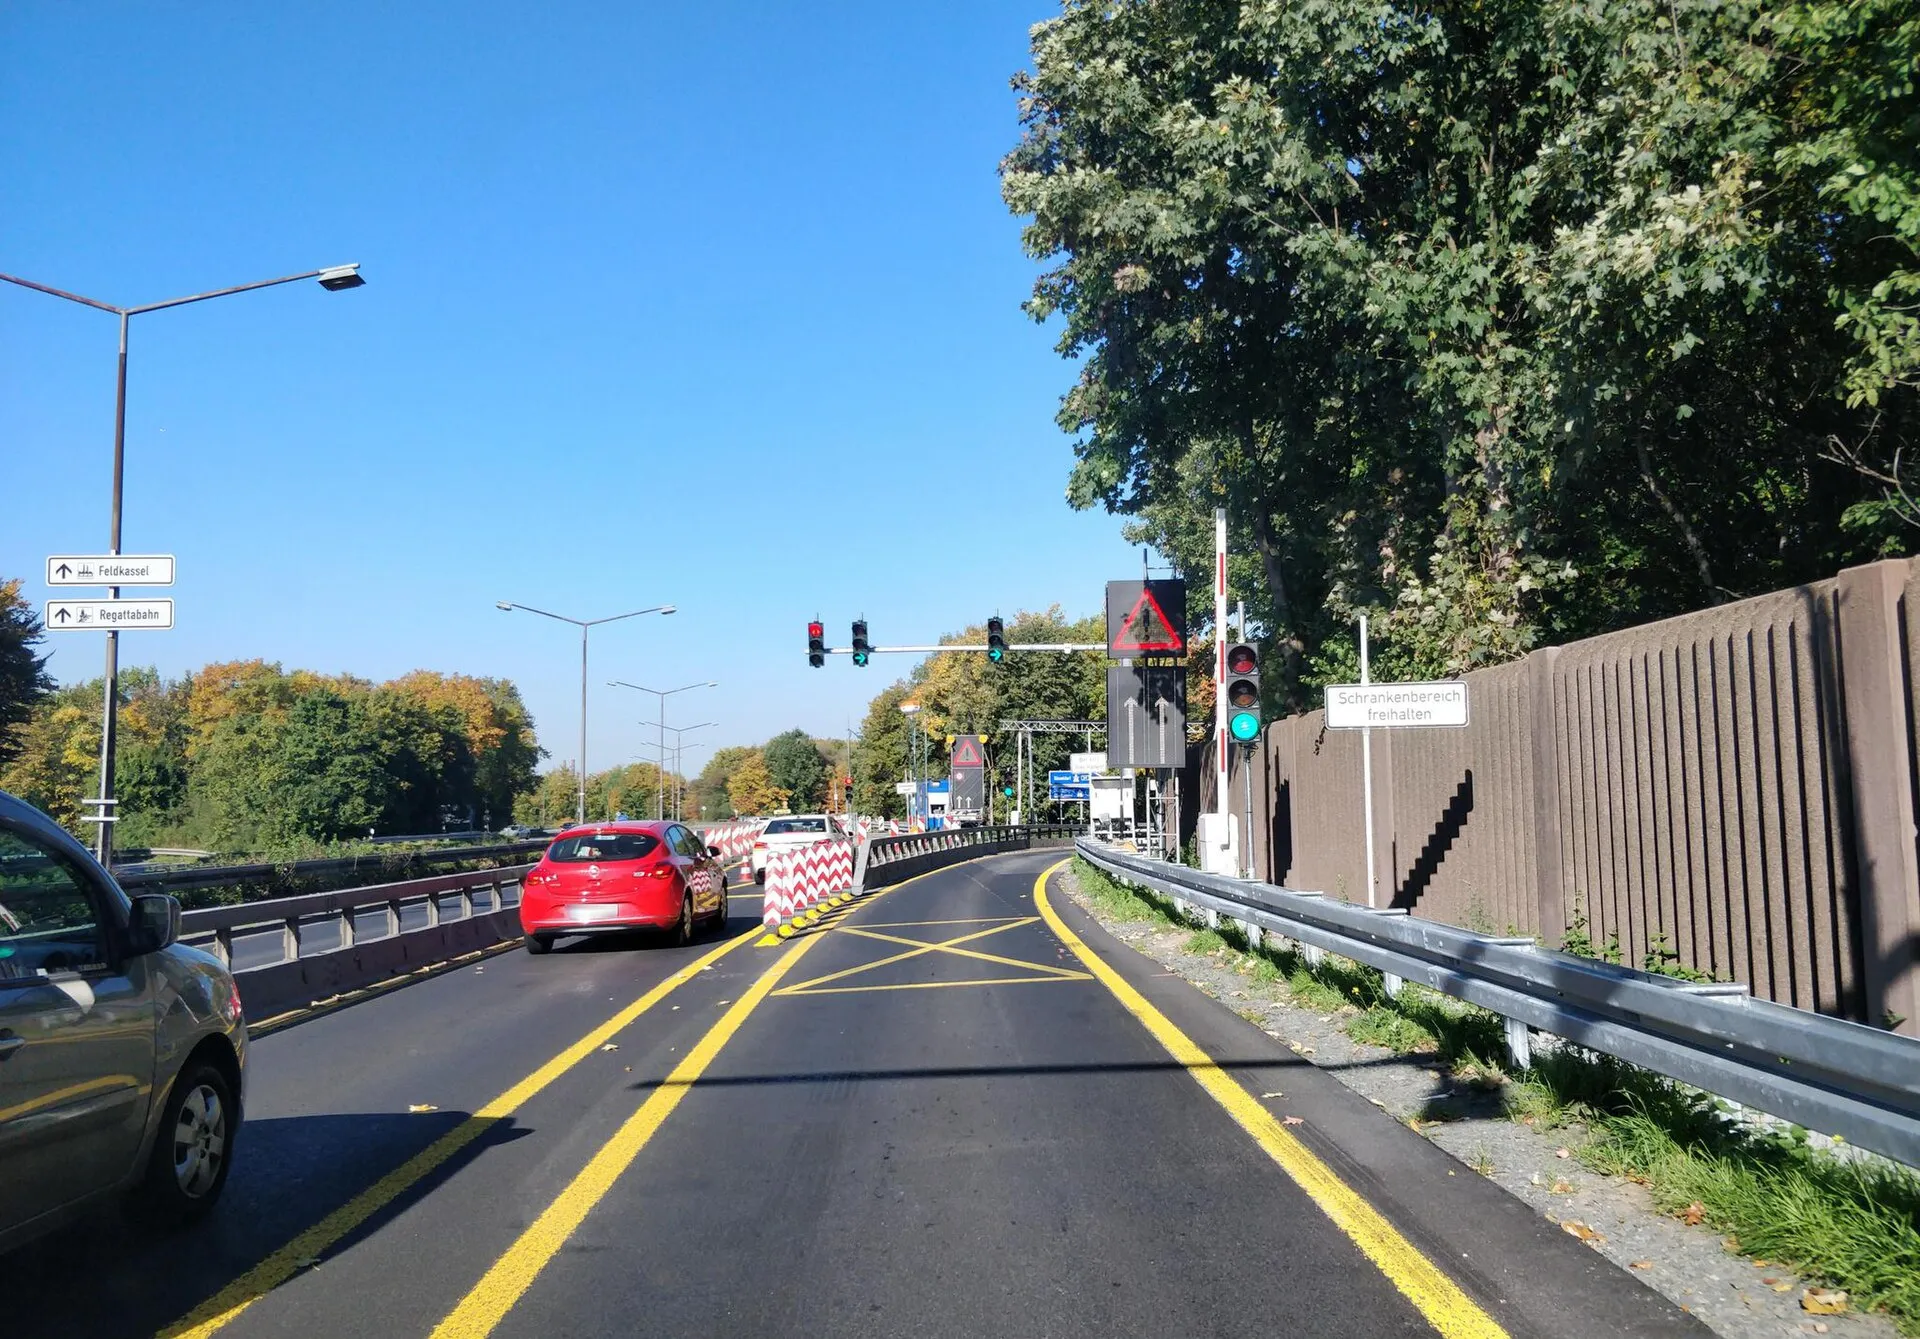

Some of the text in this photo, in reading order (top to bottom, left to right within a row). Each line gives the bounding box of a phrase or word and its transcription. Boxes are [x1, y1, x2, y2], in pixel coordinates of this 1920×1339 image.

[98, 565, 149, 576] Feldkassel
[99, 609, 159, 622] Regattabahn
[1338, 689, 1461, 705] Schrankenbereich
[1368, 707, 1432, 721] freihalten
